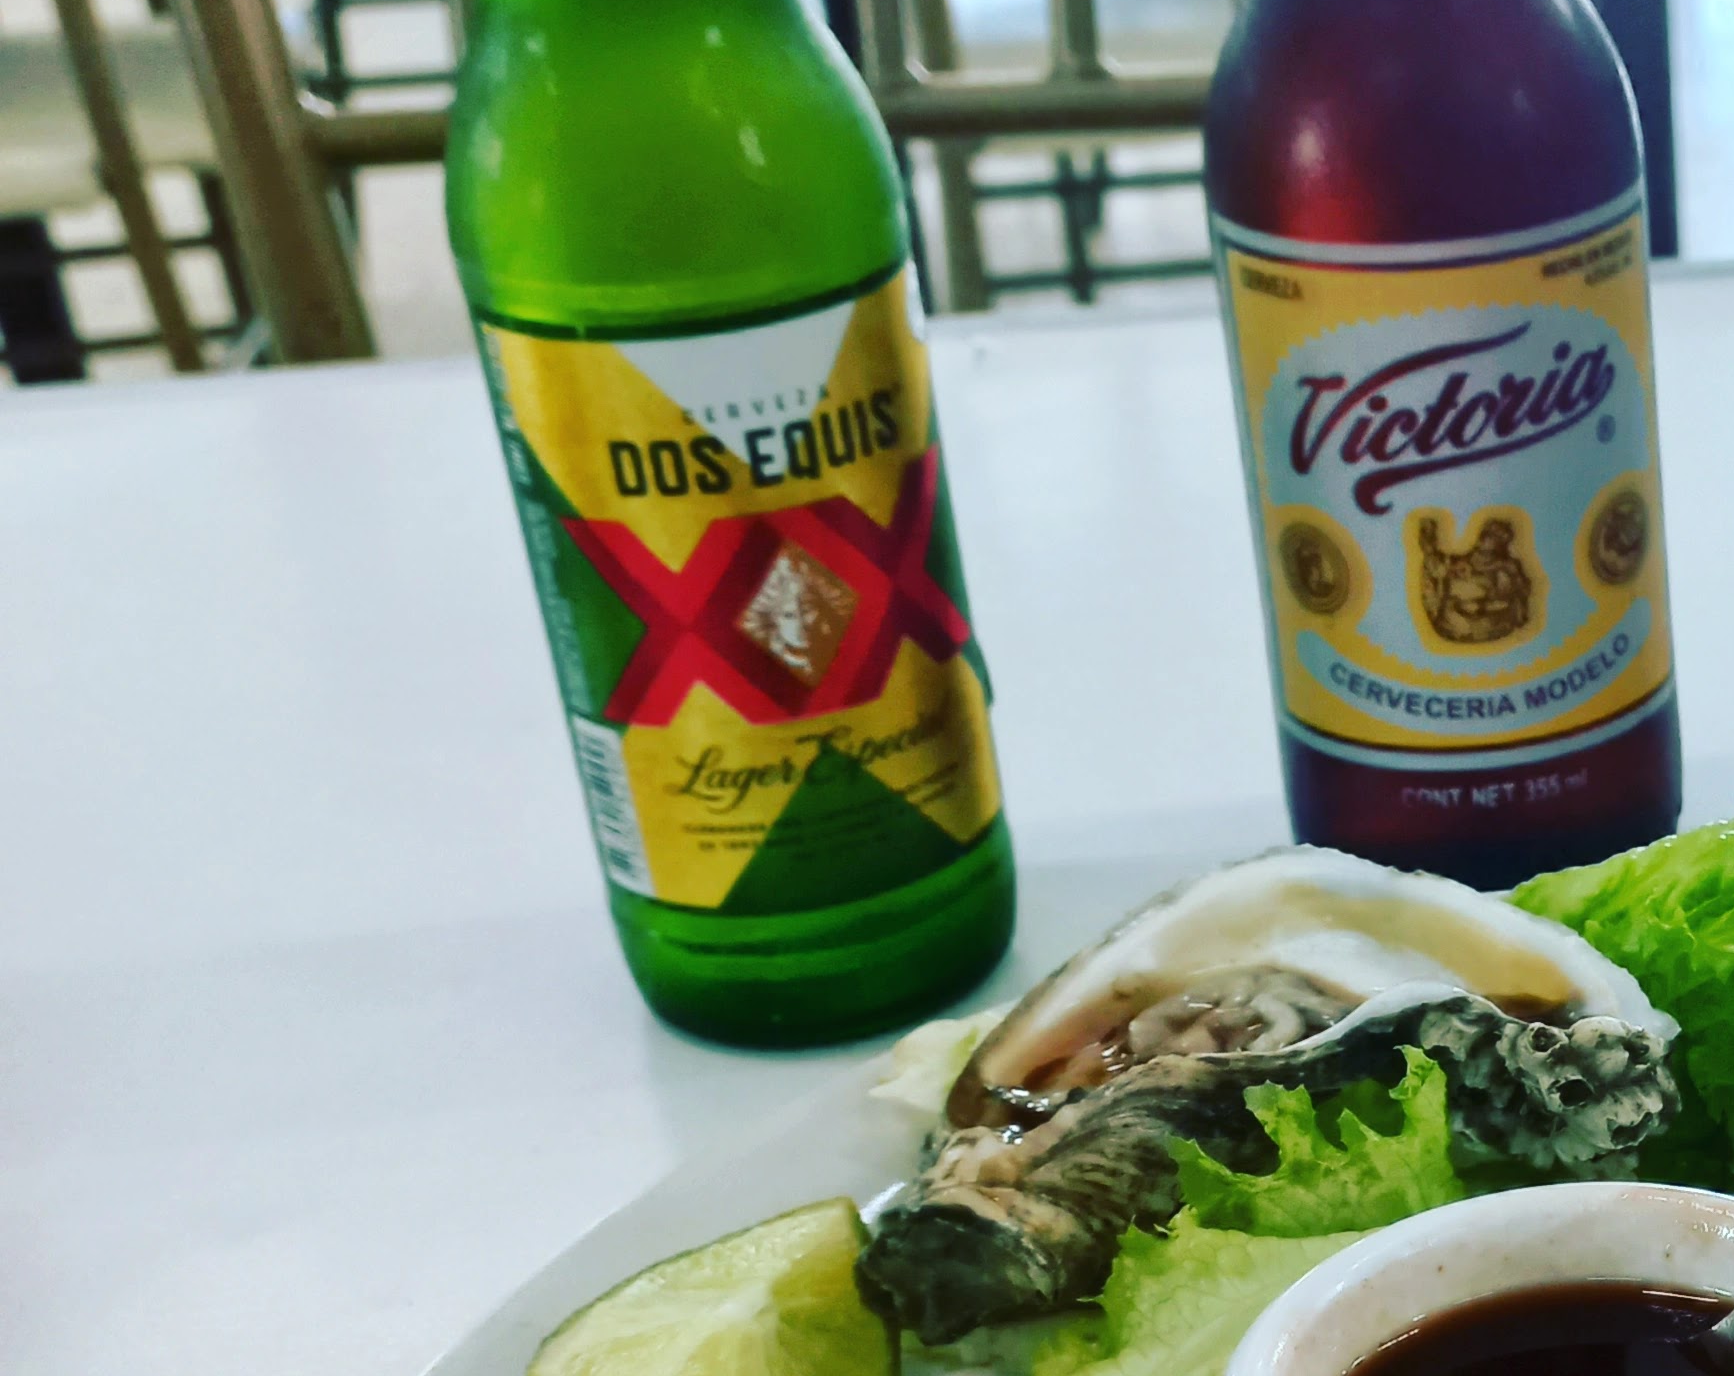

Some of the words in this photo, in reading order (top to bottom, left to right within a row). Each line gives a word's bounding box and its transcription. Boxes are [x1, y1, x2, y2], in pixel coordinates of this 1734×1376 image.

[609, 439, 732, 497] DOS
[744, 388, 901, 488] EQUIS
[1290, 321, 1616, 516] Victoria
[1329, 661, 1516, 719] CERVECERIA
[1523, 632, 1629, 710] MODELO
[664, 744, 795, 815] Lager
[1472, 782, 1516, 808] NET
[1523, 774, 1560, 802] 355
